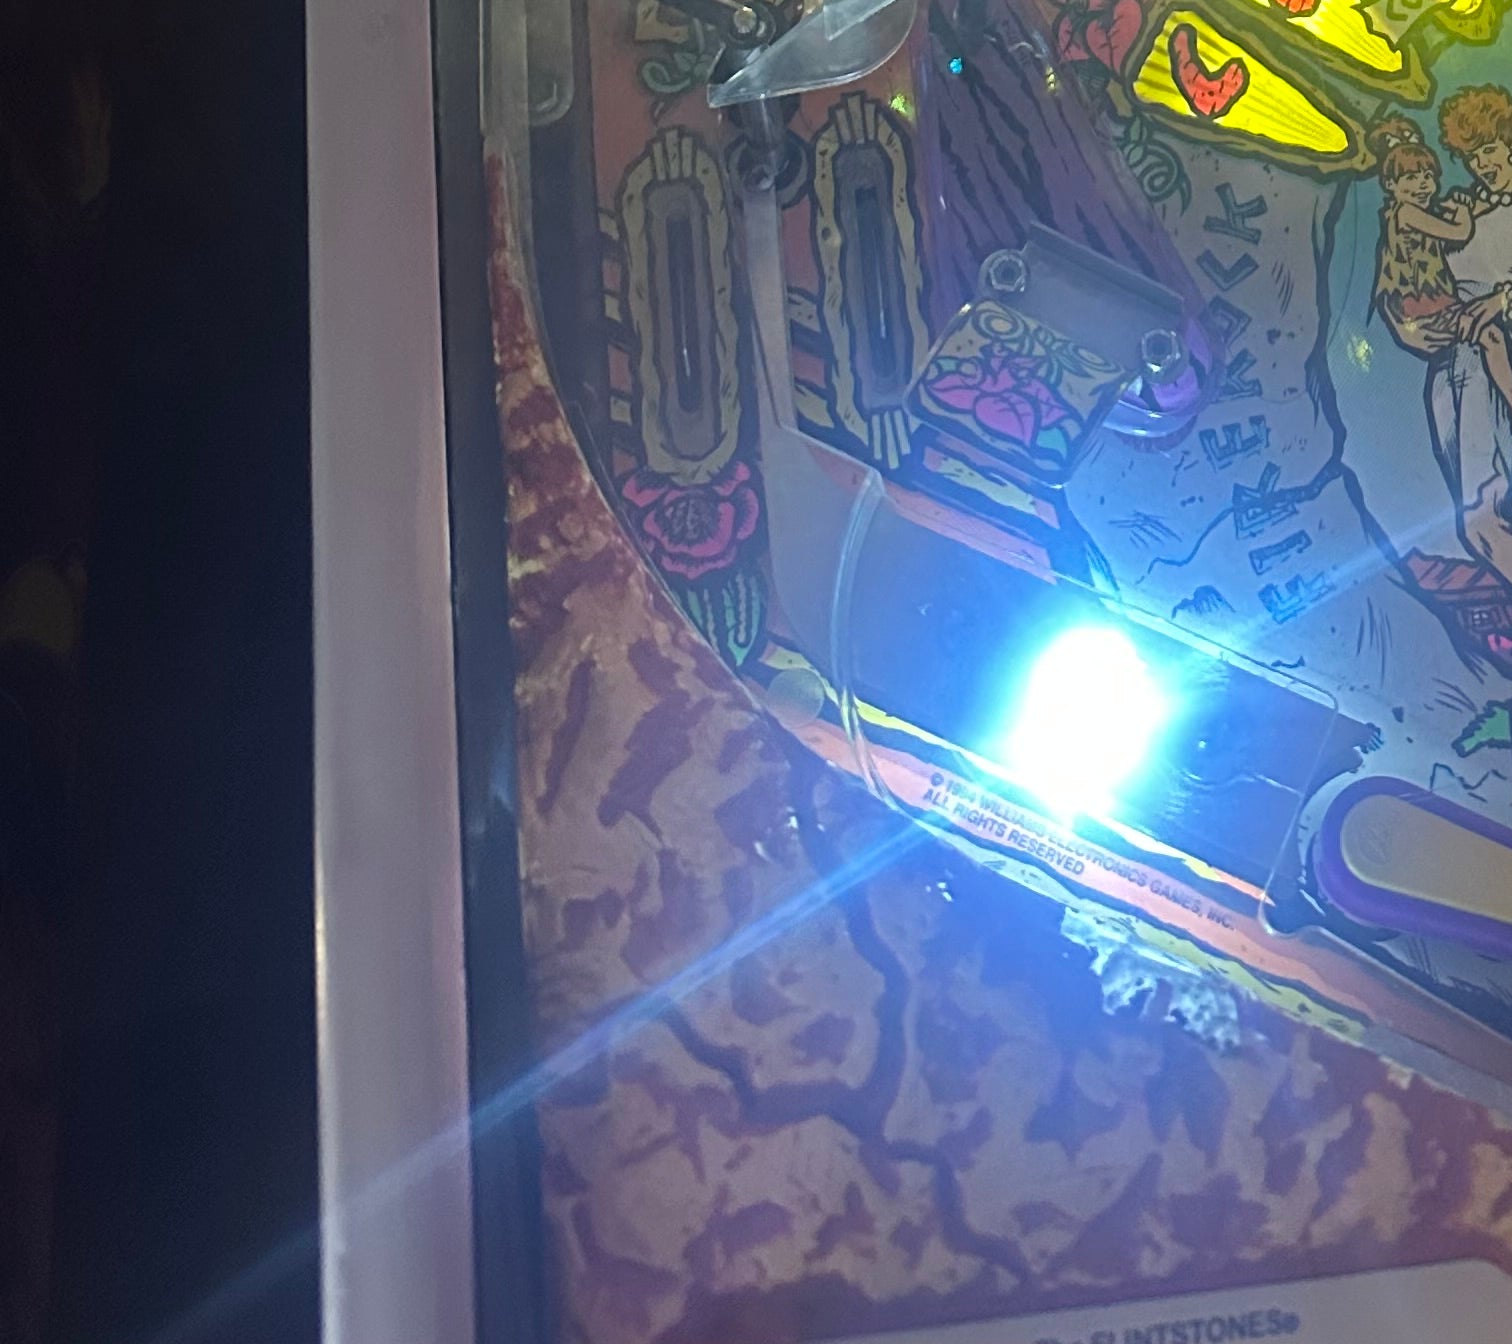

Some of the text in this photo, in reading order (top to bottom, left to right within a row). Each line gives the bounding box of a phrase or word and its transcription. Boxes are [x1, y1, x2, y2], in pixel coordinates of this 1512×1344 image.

[921, 786, 1086, 877] ALL RIGHTS RESERVED
[1046, 826, 1149, 889] ELECTRONICS
